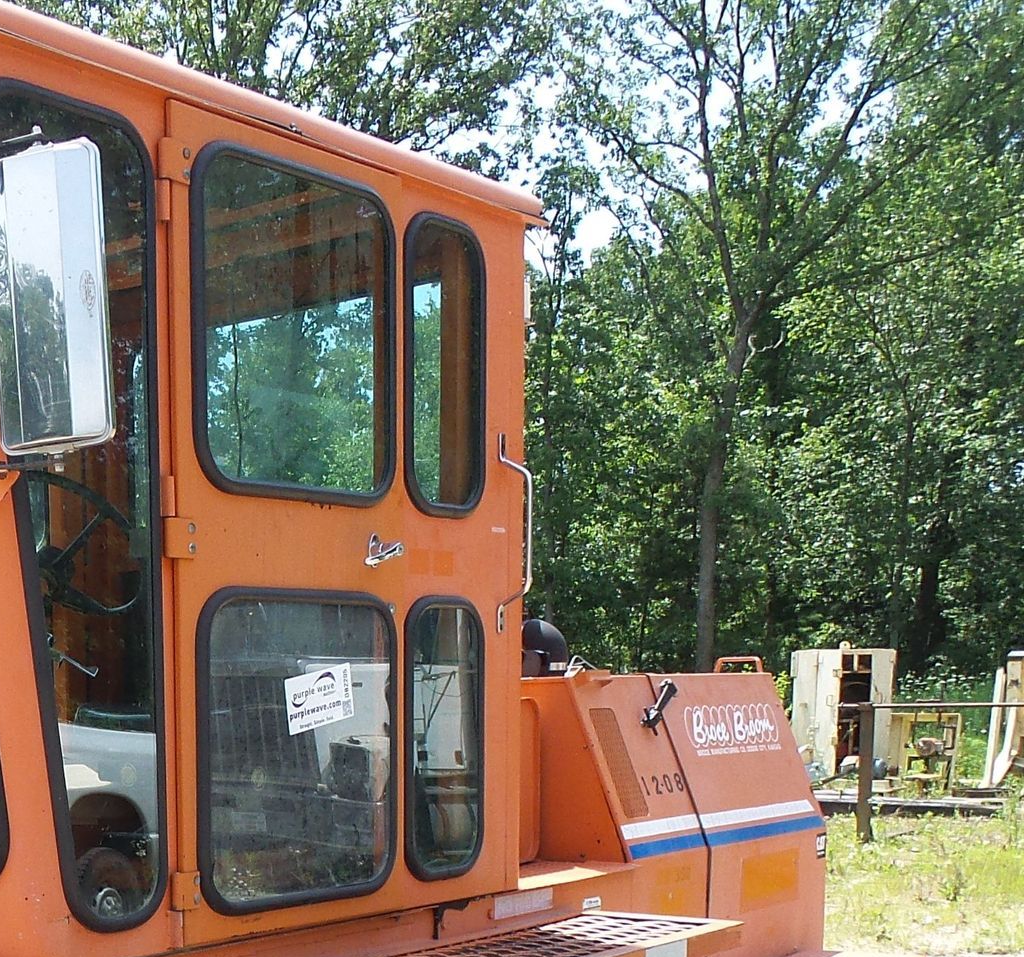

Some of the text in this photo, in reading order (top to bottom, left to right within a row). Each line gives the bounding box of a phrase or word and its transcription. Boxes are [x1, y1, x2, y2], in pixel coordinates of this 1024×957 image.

[293, 687, 315, 702] purple
[317, 683, 335, 693] wave
[289, 699, 342, 723] purplewave.com
[733, 710, 775, 742] Broom
